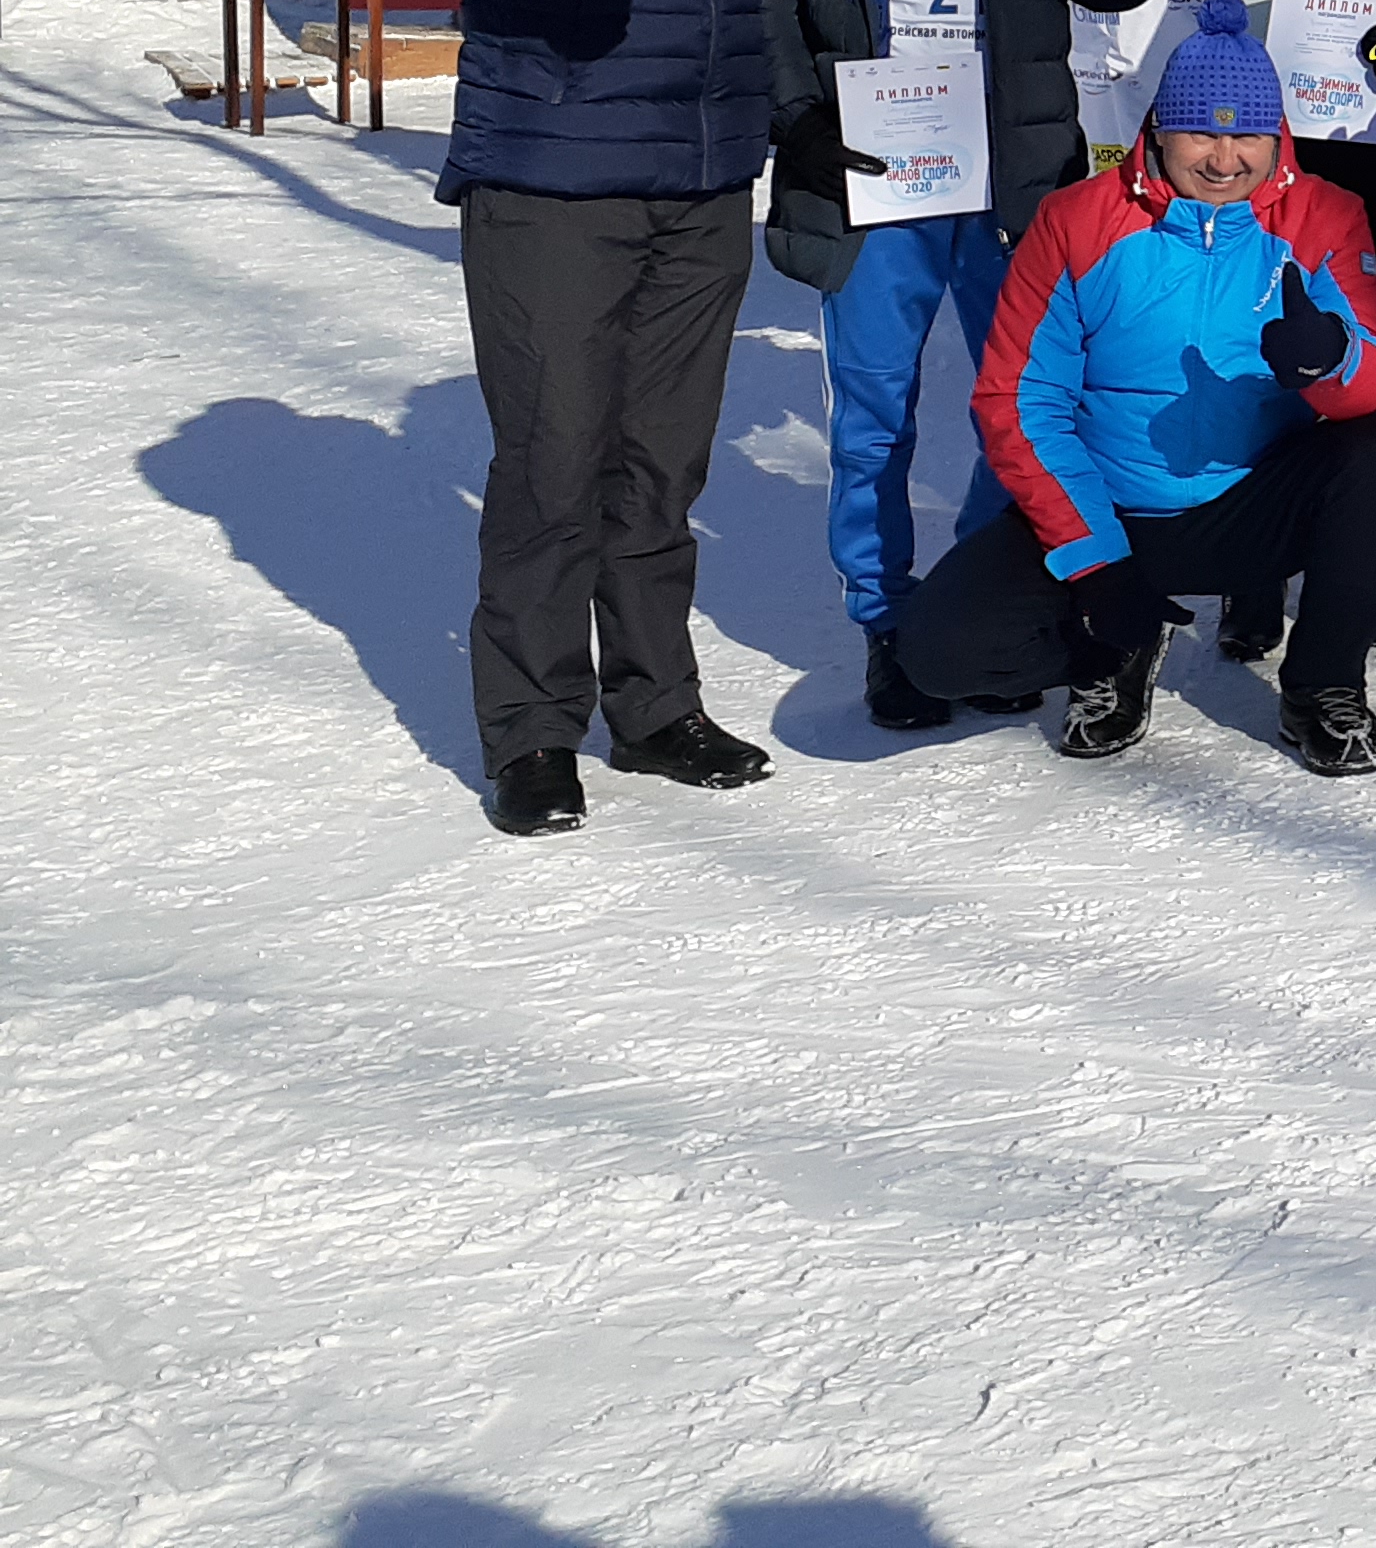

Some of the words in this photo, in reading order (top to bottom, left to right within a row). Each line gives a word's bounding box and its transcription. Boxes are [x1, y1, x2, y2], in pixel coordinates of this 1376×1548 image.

[890, 26, 938, 40] рейская
[1289, 72, 1318, 89] ДЕНЬ
[1319, 76, 1361, 93] ЗИМНИХ
[875, 84, 948, 102] ДИПЛОМ
[1295, 89, 1327, 104] ВИДОВ
[1328, 91, 1364, 109] СПОРТА
[1309, 104, 1336, 116] 2020
[908, 155, 955, 166] ЗИМНИХ
[1094, 149, 1124, 163] ASPO
[886, 169, 921, 182] ВИДОВ
[922, 166, 961, 180] СПОРТА
[904, 182, 933, 194] 2020
